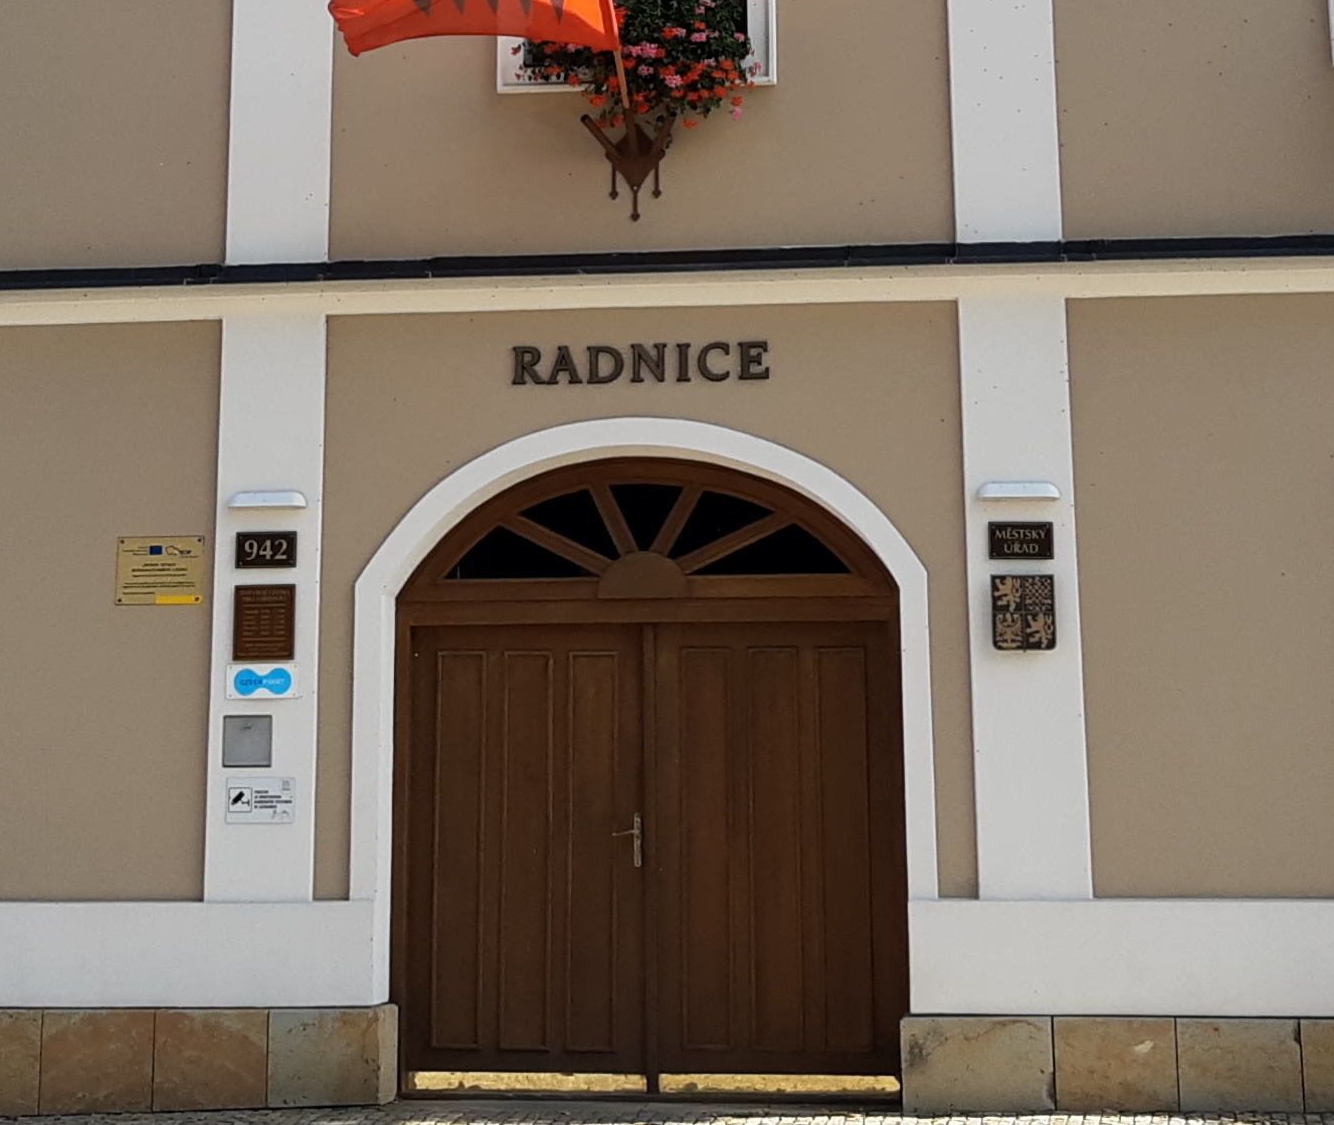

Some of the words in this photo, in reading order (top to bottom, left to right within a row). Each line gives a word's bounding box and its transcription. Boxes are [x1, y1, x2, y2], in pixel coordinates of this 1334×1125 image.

[511, 341, 770, 385] RADNICE
[244, 539, 287, 560] 942
[1004, 541, 1039, 553] ÚŘAD
